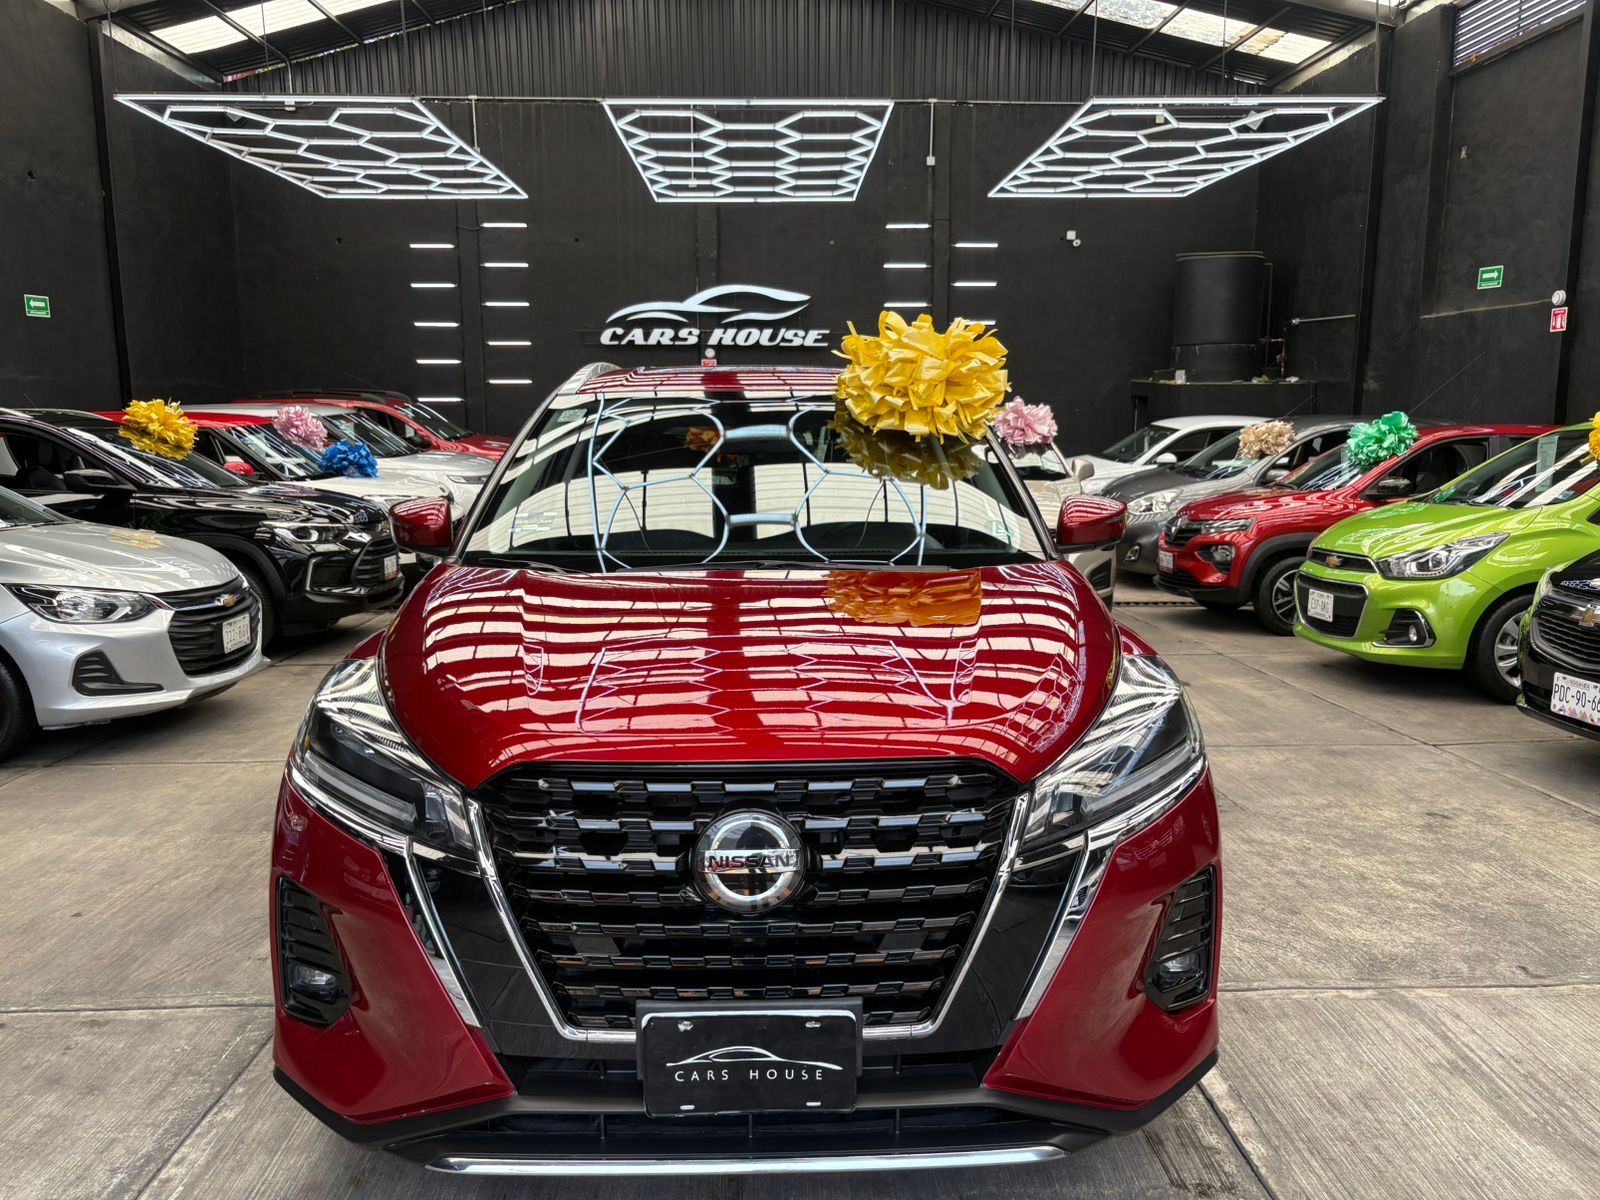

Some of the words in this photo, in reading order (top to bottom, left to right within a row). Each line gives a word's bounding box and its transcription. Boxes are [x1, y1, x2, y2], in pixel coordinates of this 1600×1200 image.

[600, 327, 699, 346] CARS
[707, 328, 830, 347] HOUSE
[707, 854, 790, 868] NISSAN
[674, 1069, 729, 1082] CARS
[749, 1068, 823, 1080] HOUSE
